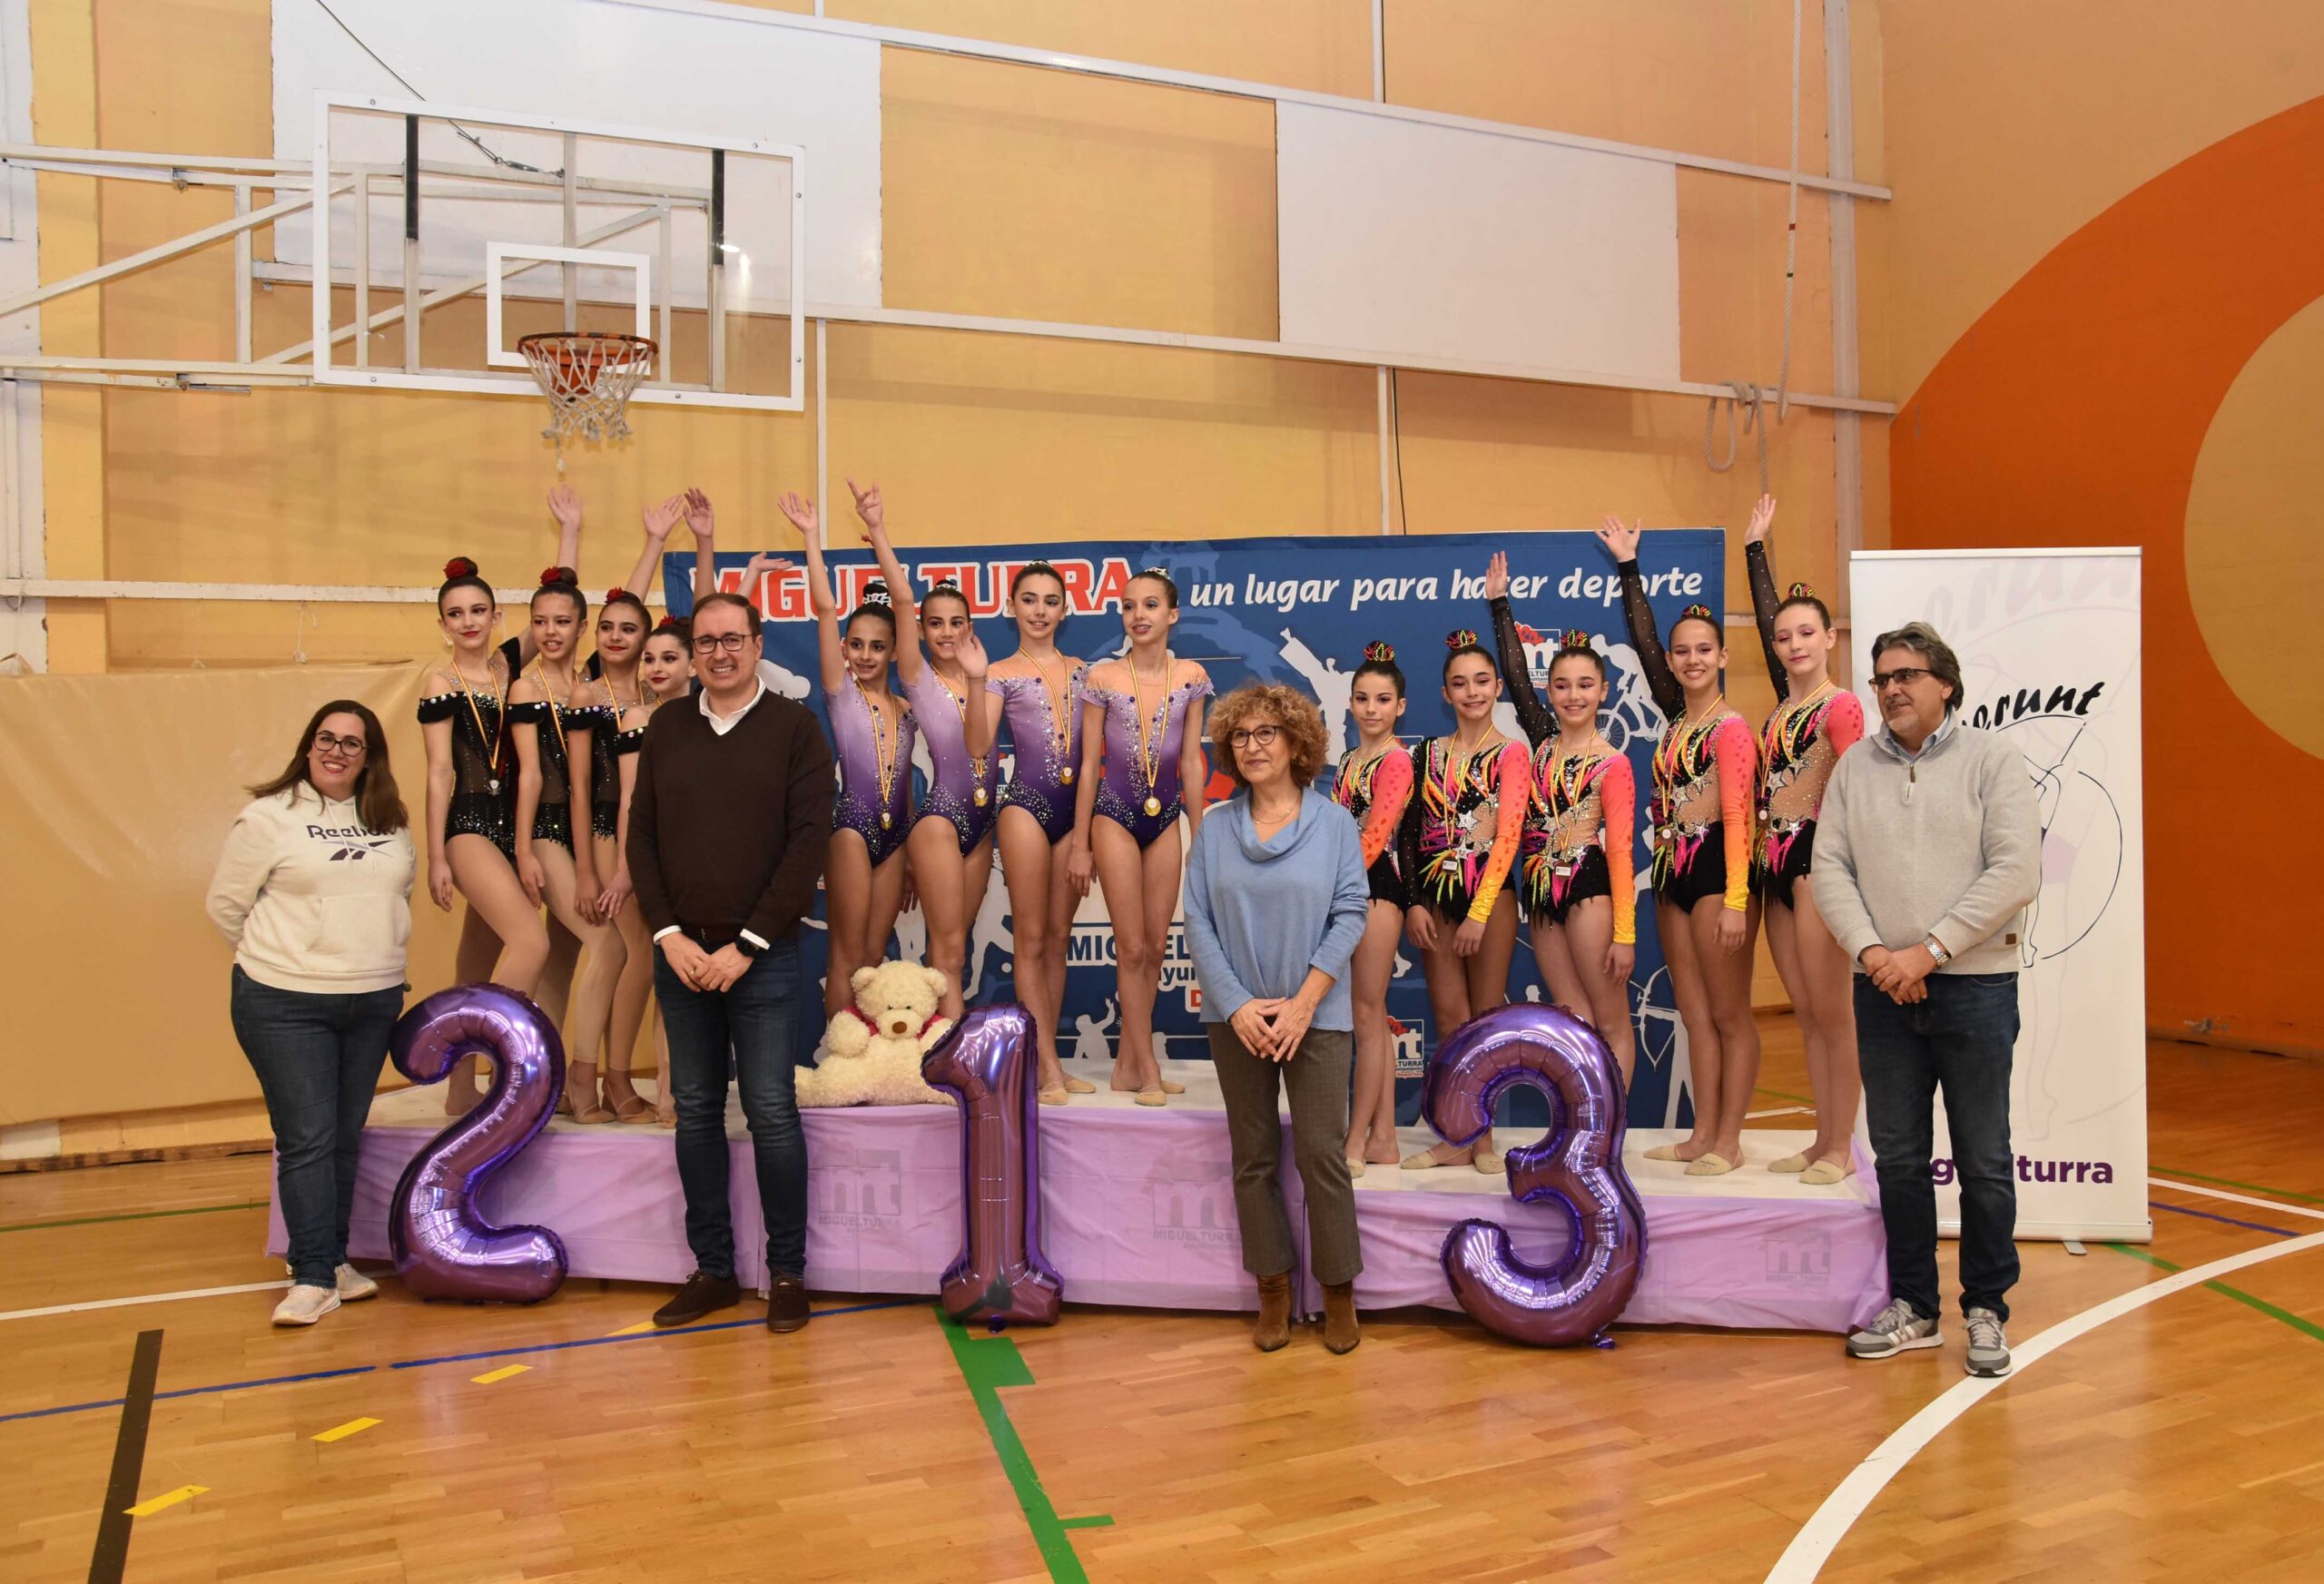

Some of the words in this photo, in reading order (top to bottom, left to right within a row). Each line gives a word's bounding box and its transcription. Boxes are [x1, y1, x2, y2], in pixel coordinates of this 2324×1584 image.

[1190, 582, 1235, 607] un
[1245, 574, 1340, 613] lugar
[1350, 576, 1439, 611] para
[1451, 568, 1548, 600] haer
[1558, 566, 1703, 607] deprte
[306, 824, 396, 840] Reeb
